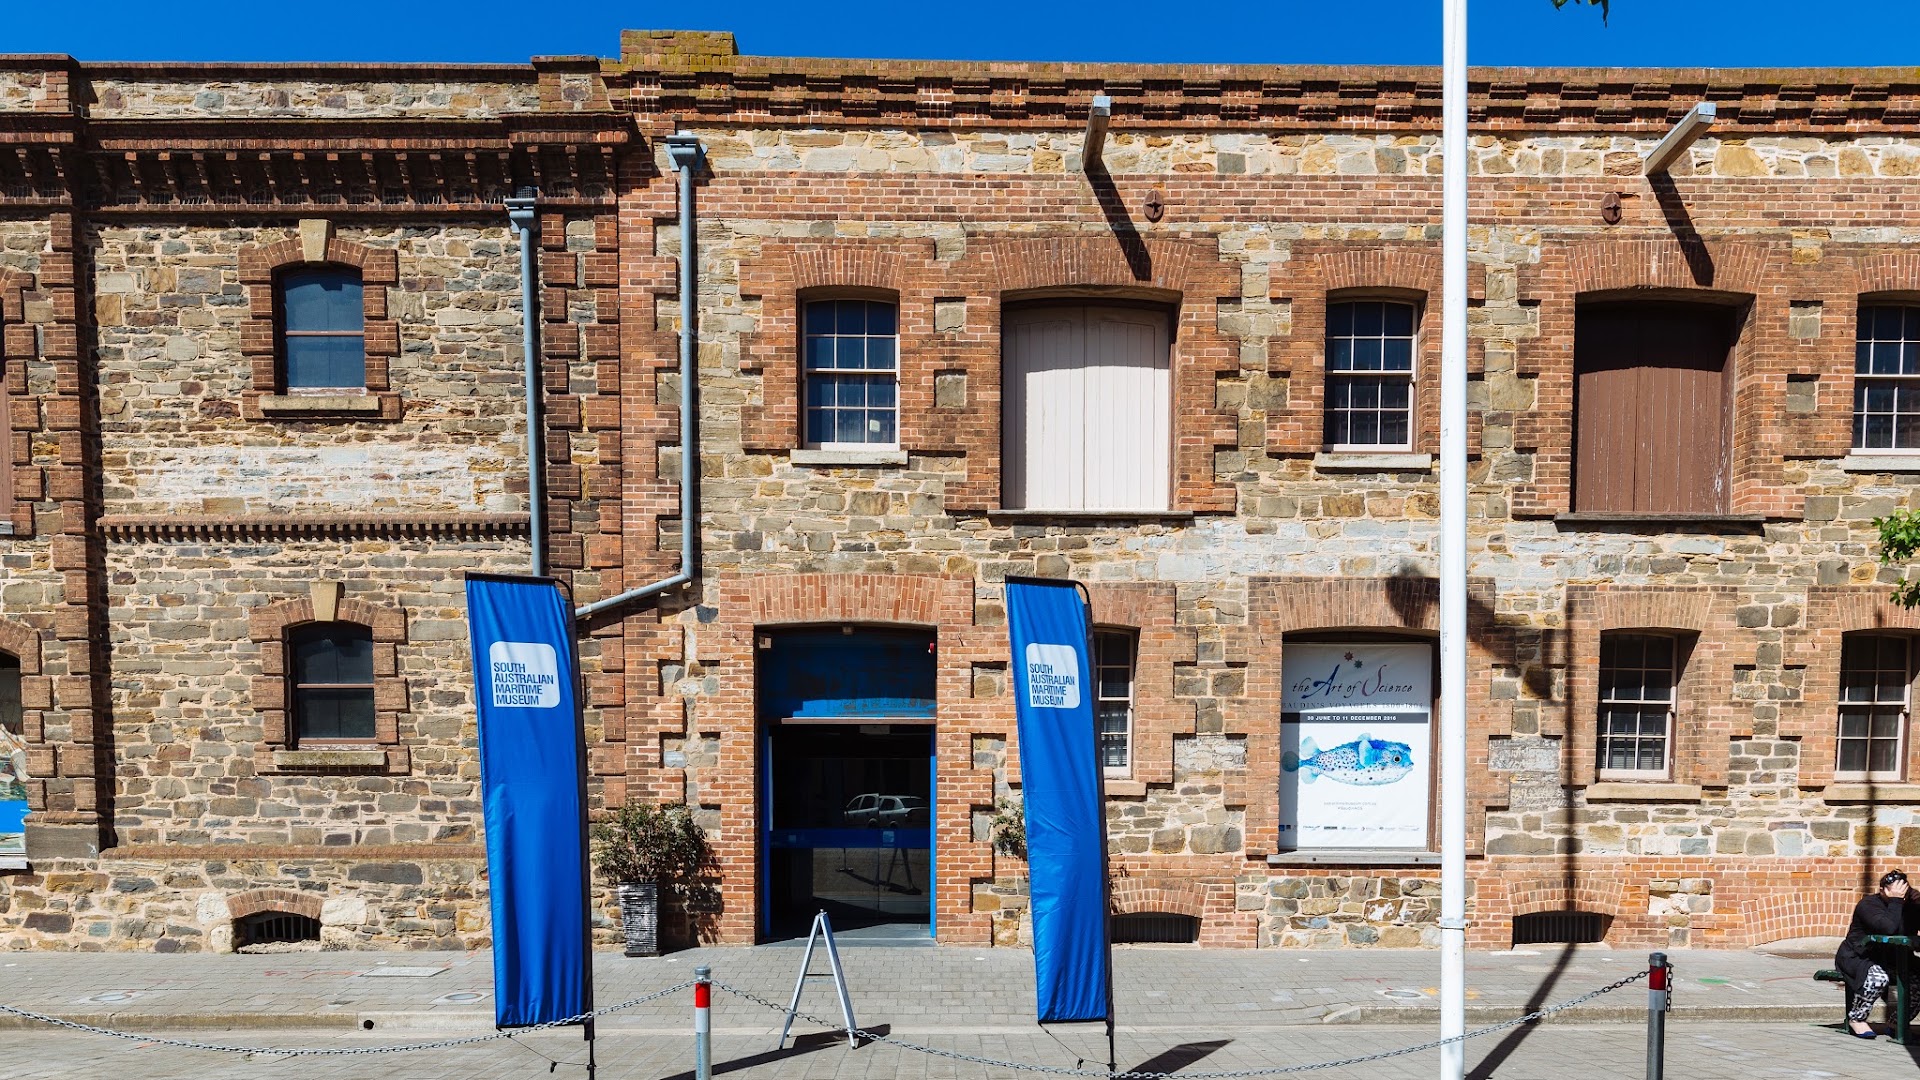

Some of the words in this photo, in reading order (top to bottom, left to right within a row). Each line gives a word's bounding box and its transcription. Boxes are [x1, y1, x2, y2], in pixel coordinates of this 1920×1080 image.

[494, 662, 525, 673] SOUTH
[1030, 663, 1053, 674] SOUTH
[494, 673, 554, 684] AUSTRALIAN
[1031, 674, 1075, 685] AUSTRALIAN
[1301, 664, 1342, 699] Art
[1361, 664, 1413, 697] Science
[496, 684, 543, 694] MARITIME
[1032, 685, 1067, 695] MARITIME
[1292, 677, 1311, 693] the
[1343, 681, 1362, 699] of
[496, 694, 540, 705] MUSEUM
[1033, 695, 1065, 706] MUSEUM
